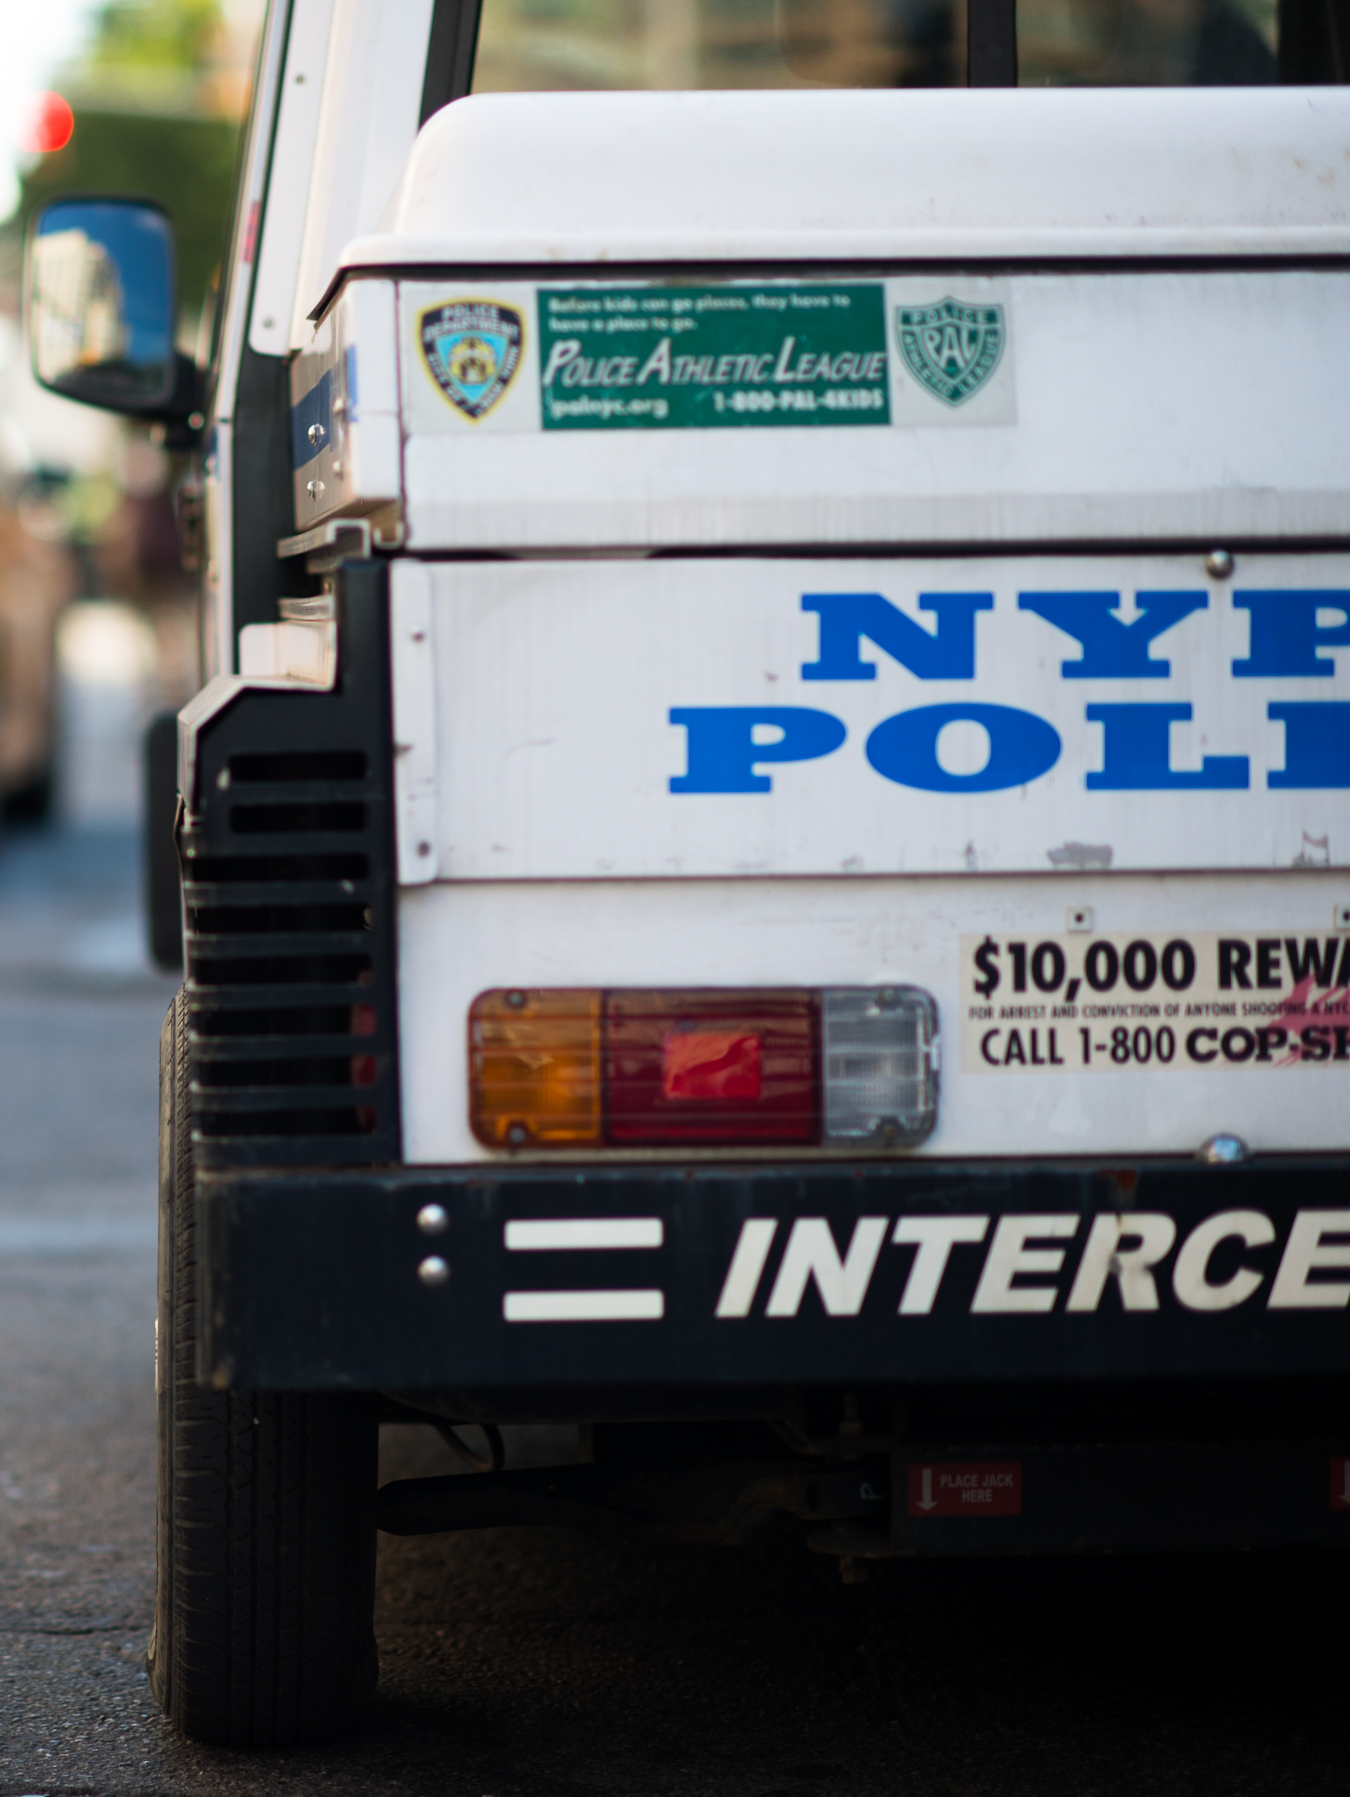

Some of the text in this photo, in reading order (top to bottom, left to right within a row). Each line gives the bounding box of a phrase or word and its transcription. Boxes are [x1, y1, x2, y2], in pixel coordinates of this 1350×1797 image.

[442, 304, 500, 321] POLICE
[548, 297, 601, 313] Before
[604, 295, 638, 312] kids
[641, 298, 669, 312] can
[671, 298, 693, 315] go
[752, 293, 788, 312] they
[790, 292, 831, 309] have
[832, 293, 851, 308] to
[912, 307, 988, 324] POLICE
[548, 316, 590, 333] have
[592, 318, 605, 333] a
[607, 315, 649, 335] place
[651, 316, 669, 331] to
[542, 334, 889, 388] POLICE ATHLETIC LEAGUE
[923, 327, 978, 369] PAL
[958, 333, 998, 393] LEAGUE
[551, 388, 884, 421] palnyc.org 1-800-PAL-4KIDS
[800, 588, 1350, 681] NYP
[973, 935, 1197, 1003] $10,000
[969, 1005, 994, 1019] FOR
[1000, 1005, 1046, 1019] ARREST
[1052, 1005, 1078, 1018] AND
[1082, 1004, 1160, 1018] CONVICTION
[1164, 1003, 1180, 1016] OF
[1185, 1003, 1237, 1017] ANYONE
[980, 1027, 1064, 1065] CALL
[1079, 1026, 1176, 1064] 1-800
[714, 1209, 1350, 1317] INTERCE
[940, 1474, 1013, 1488] PLACE JACK
[962, 1489, 993, 1502] HERE
